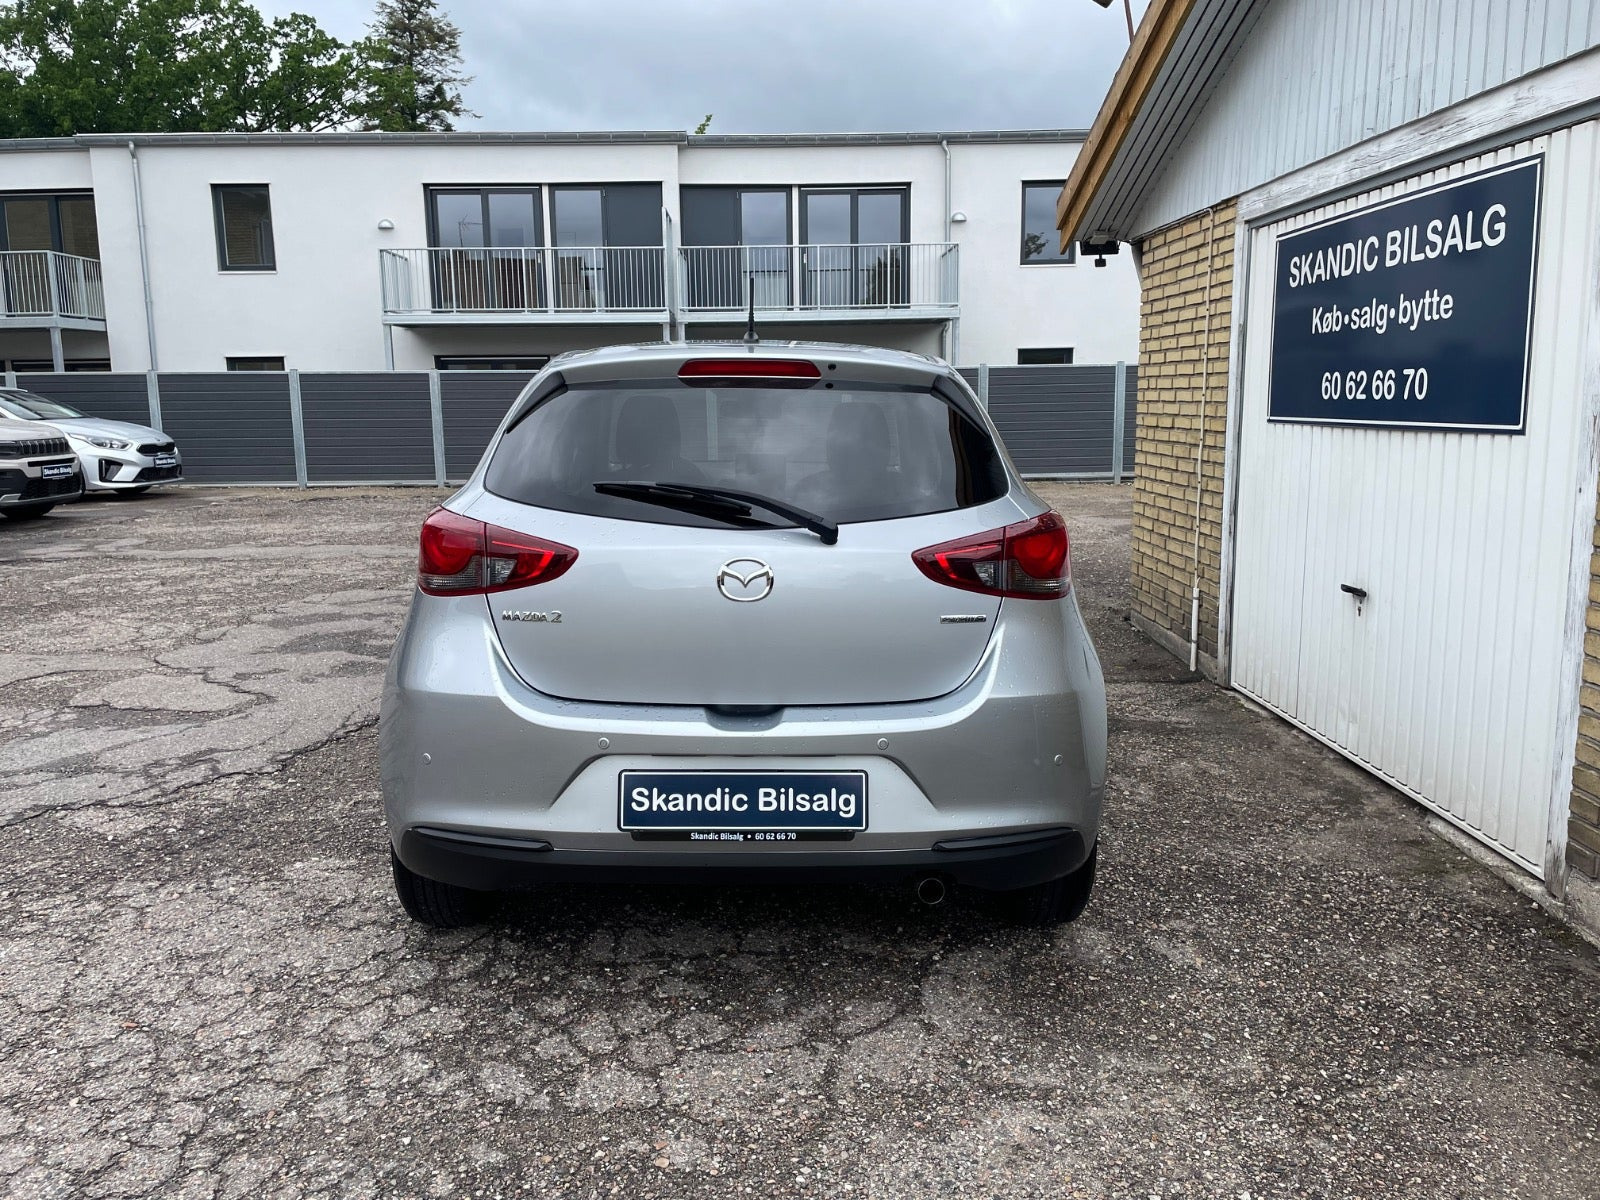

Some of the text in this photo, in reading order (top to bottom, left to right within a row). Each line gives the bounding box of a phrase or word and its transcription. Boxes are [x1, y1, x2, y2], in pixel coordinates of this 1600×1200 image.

[1289, 203, 1507, 288] SKANDIC BILSALG
[1321, 367, 1428, 400] 60 62 66 70
[631, 787, 857, 818] Skandic Bilsalg
[690, 832, 797, 842] Skandic Bilsalg 60 62 66 70
